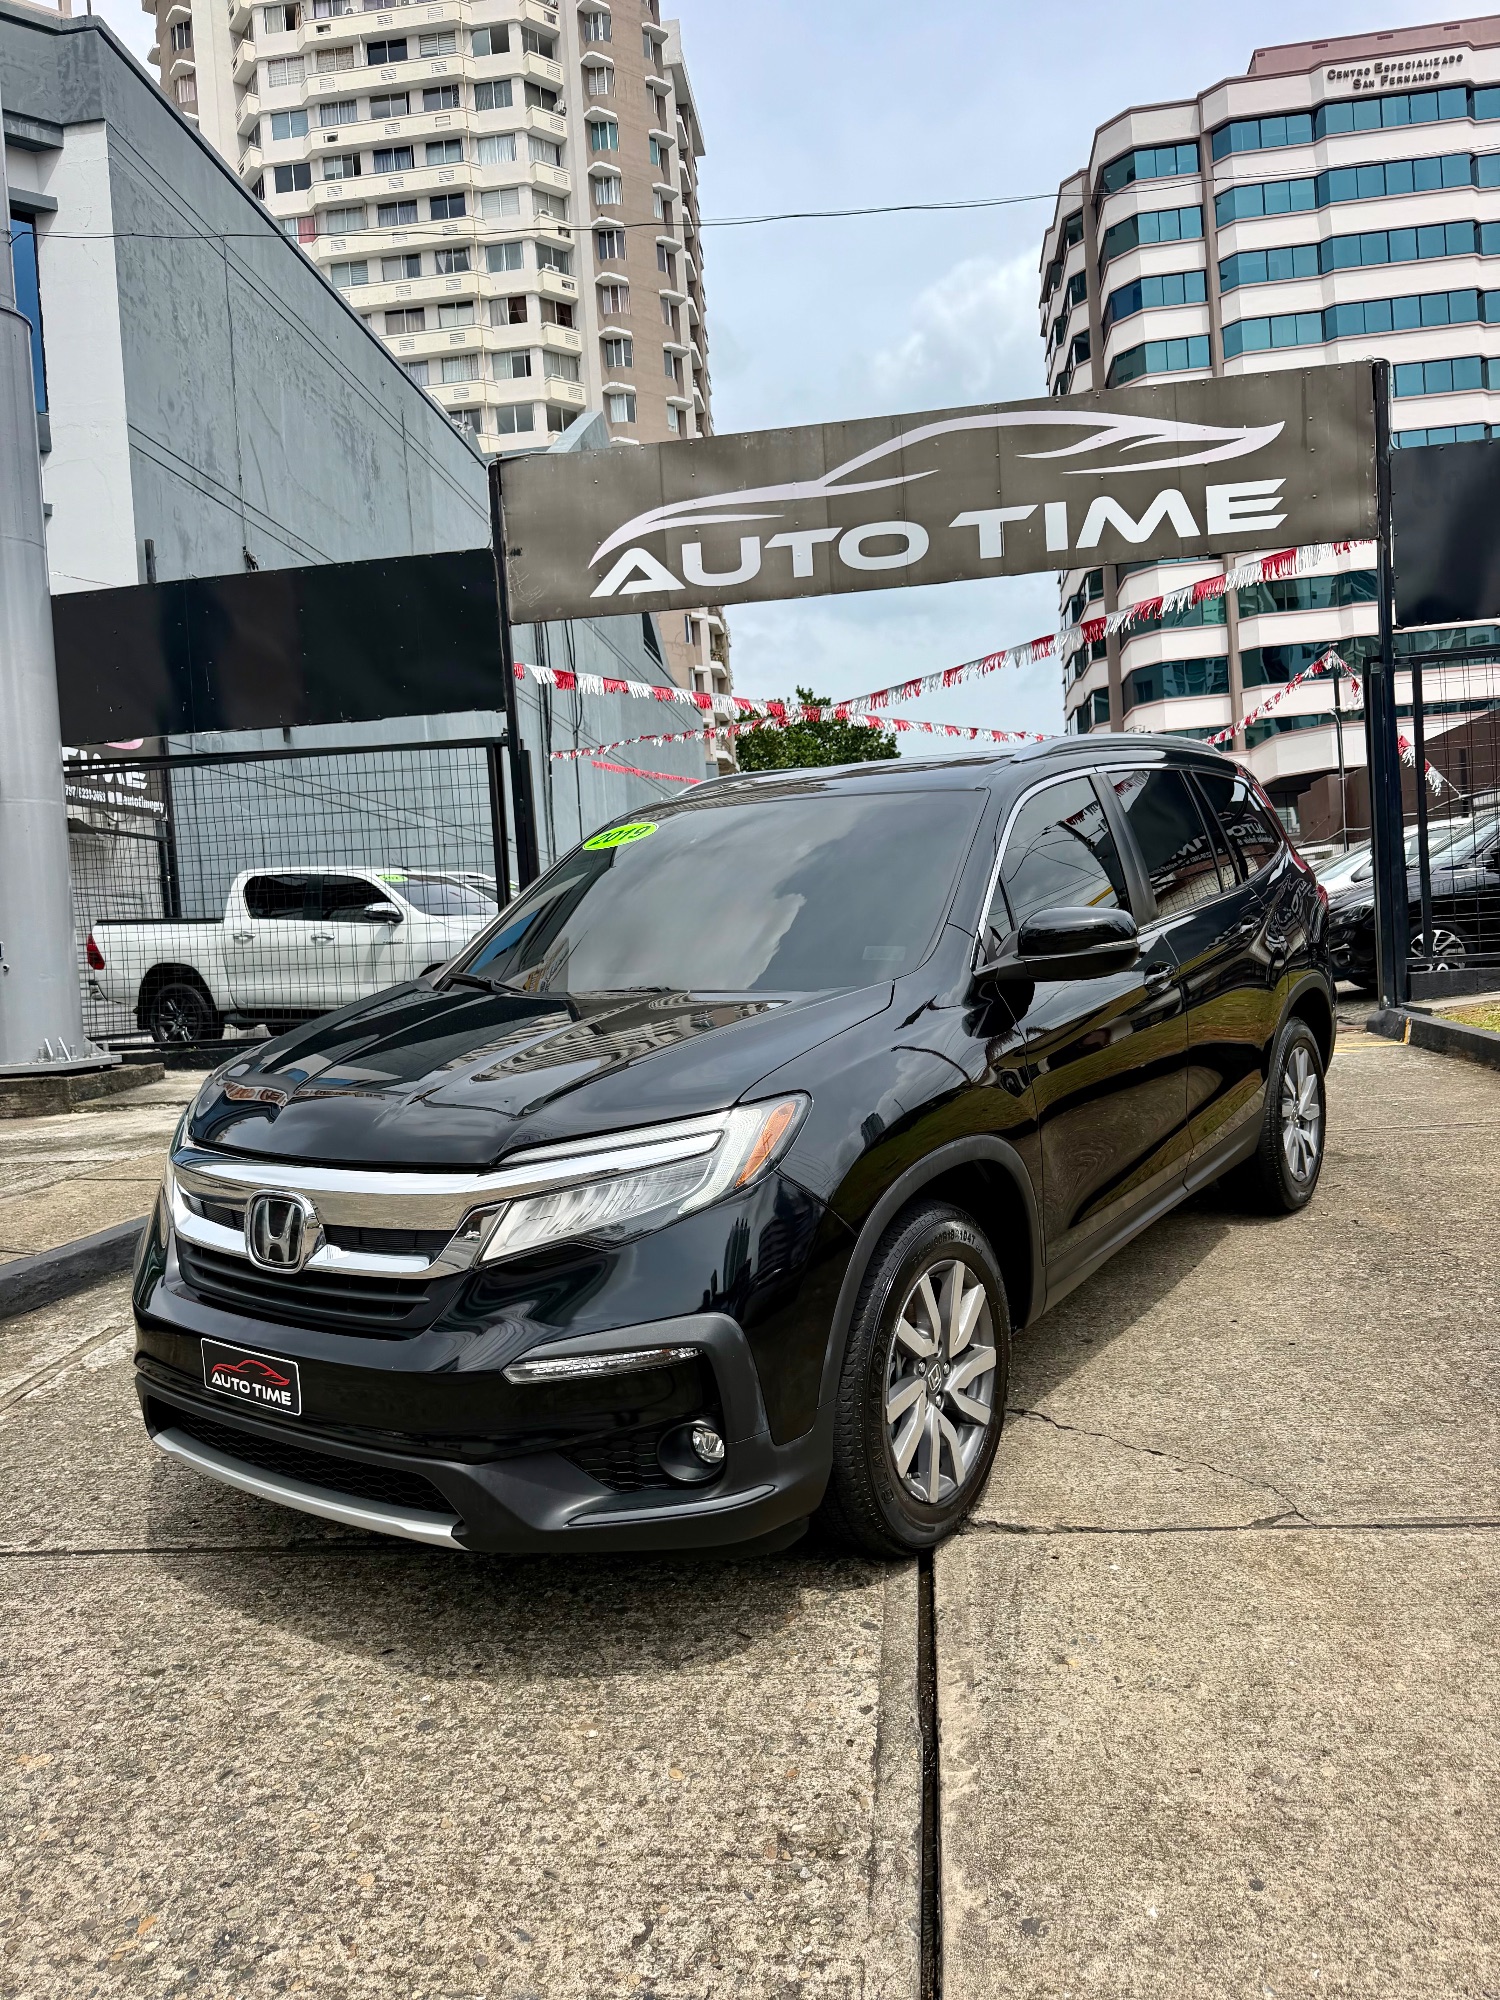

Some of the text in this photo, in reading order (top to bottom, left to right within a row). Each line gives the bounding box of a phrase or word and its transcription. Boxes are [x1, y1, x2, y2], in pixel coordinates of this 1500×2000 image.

[1327, 54, 1464, 81] CENTRO ESPECIALIZADO
[1353, 71, 1440, 90] SAN FERNANDO
[589, 478, 1288, 598] AUTO TIME
[211, 1371, 292, 1406] AUTO TIME
